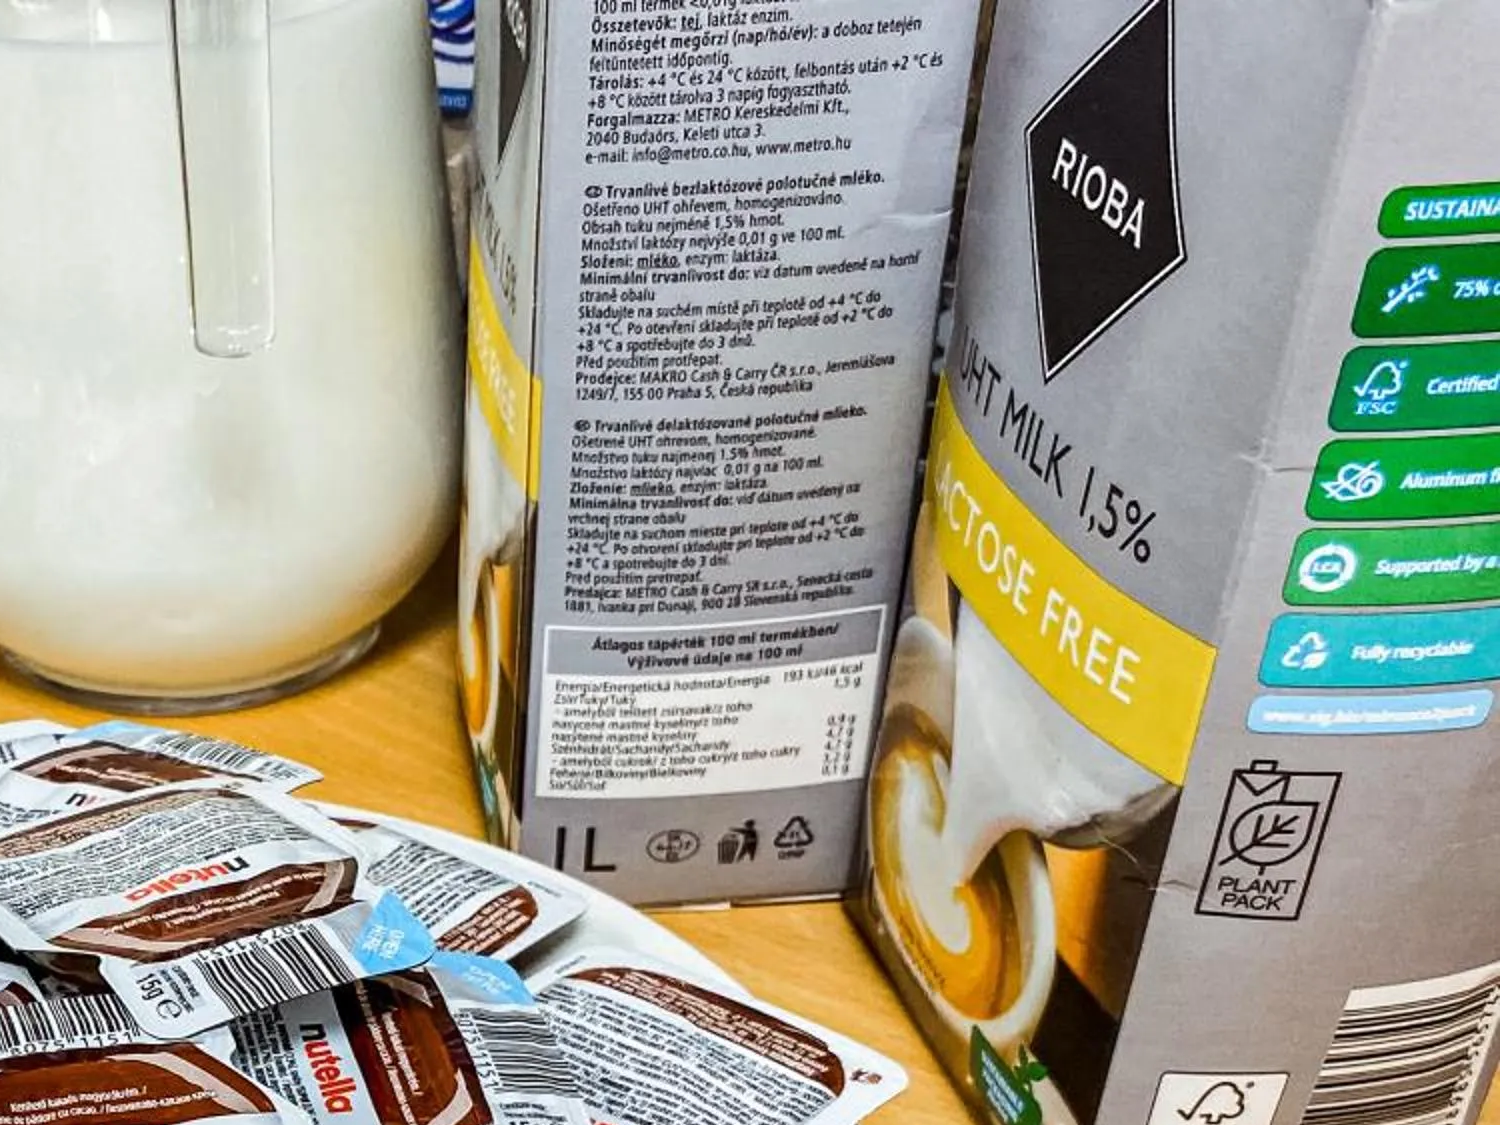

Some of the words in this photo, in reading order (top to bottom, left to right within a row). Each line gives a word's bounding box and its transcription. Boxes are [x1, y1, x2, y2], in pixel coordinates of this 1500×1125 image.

[1051, 138, 1146, 250] RIOBA
[1453, 280, 1490, 299] 75%
[1426, 372, 1500, 395] Certified
[1355, 401, 1396, 415] FSC
[1000, 387, 1072, 498] MILK
[1079, 466, 1157, 564] 1,5%
[1400, 470, 1487, 489] Aluminum
[934, 448, 1036, 616] ACTOSE
[1040, 587, 1141, 705] FREE
[1374, 555, 1465, 579] Supported
[1351, 645, 1392, 663] Fully
[583, 827, 617, 872] L
[124, 856, 250, 902] nutella
[1217, 876, 1296, 895] PLANT
[1220, 892, 1286, 911] PACK
[137, 972, 164, 1001] 15g
[299, 1023, 357, 1116] nutella
